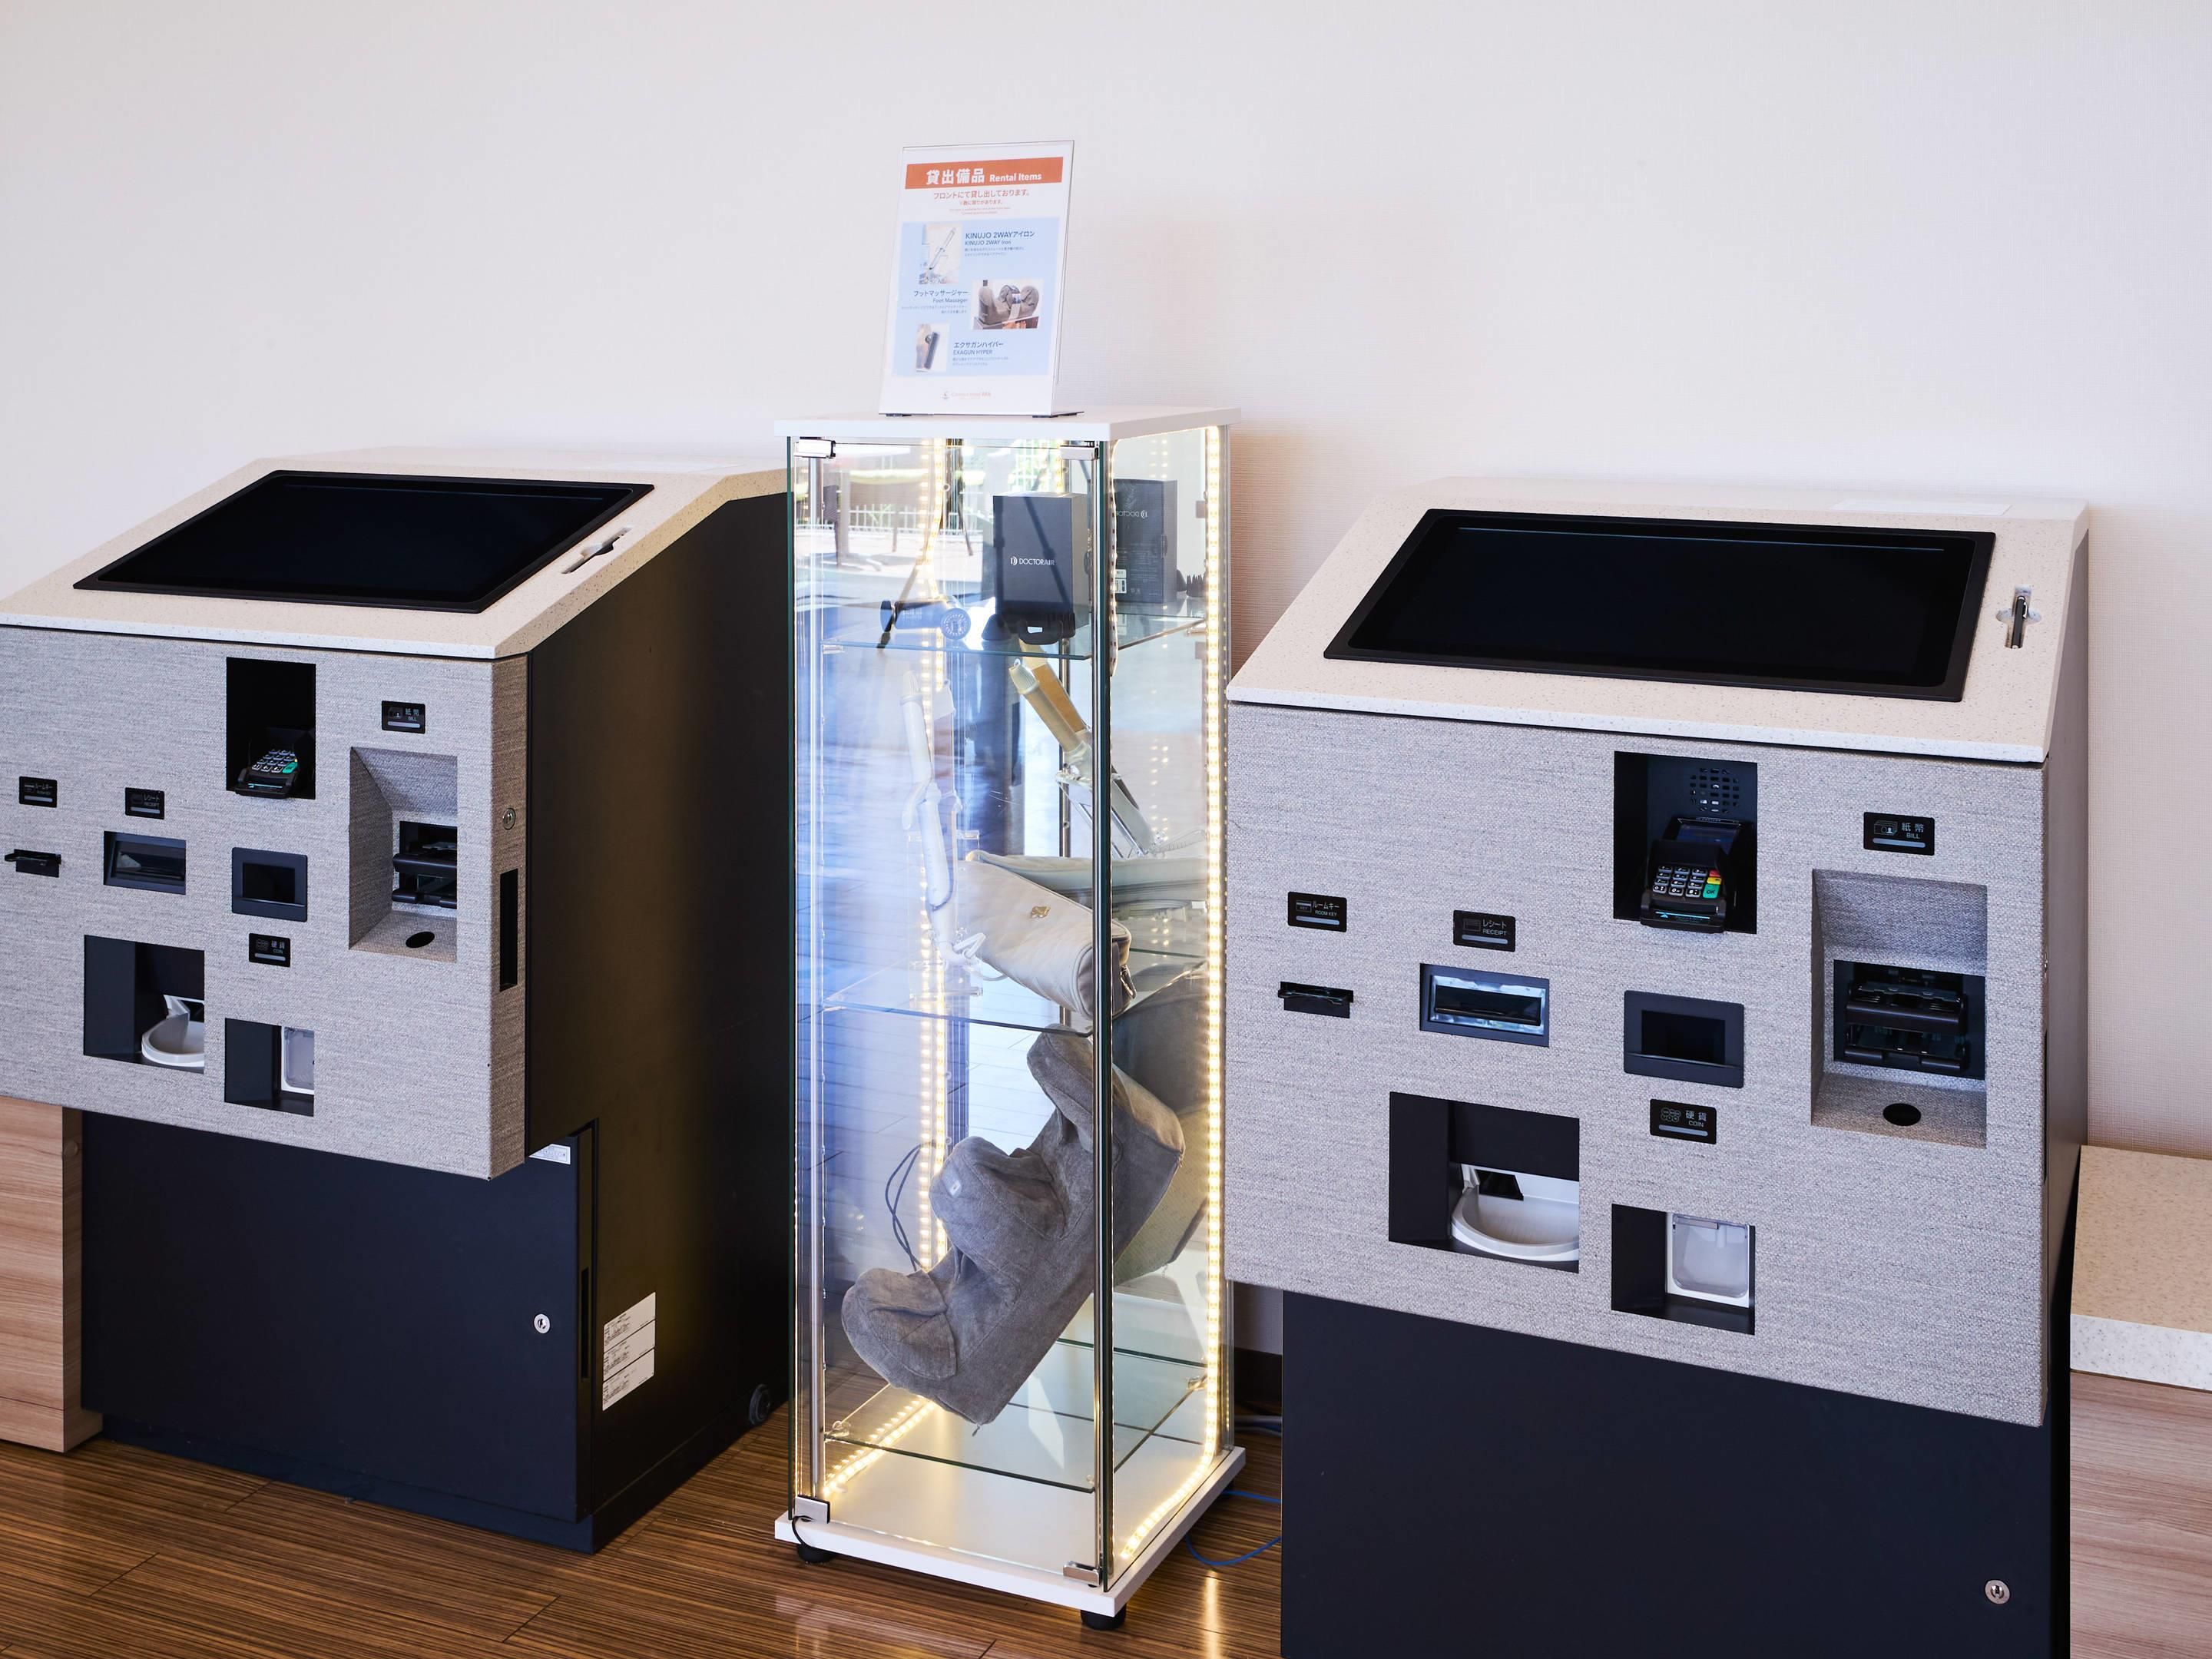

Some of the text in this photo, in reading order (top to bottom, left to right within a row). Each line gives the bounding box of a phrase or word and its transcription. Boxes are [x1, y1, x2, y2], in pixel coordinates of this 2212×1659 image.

[926, 168, 1042, 185] 貸出備品 Rental Items
[933, 189, 1030, 200] フロントにて貸し出しております。
[993, 230, 1035, 239] 2WAYアイロン
[1018, 558, 1055, 566] DOCTORAIR
[1313, 900, 1339, 910] ルームキー
[1482, 919, 1507, 929] レシート
